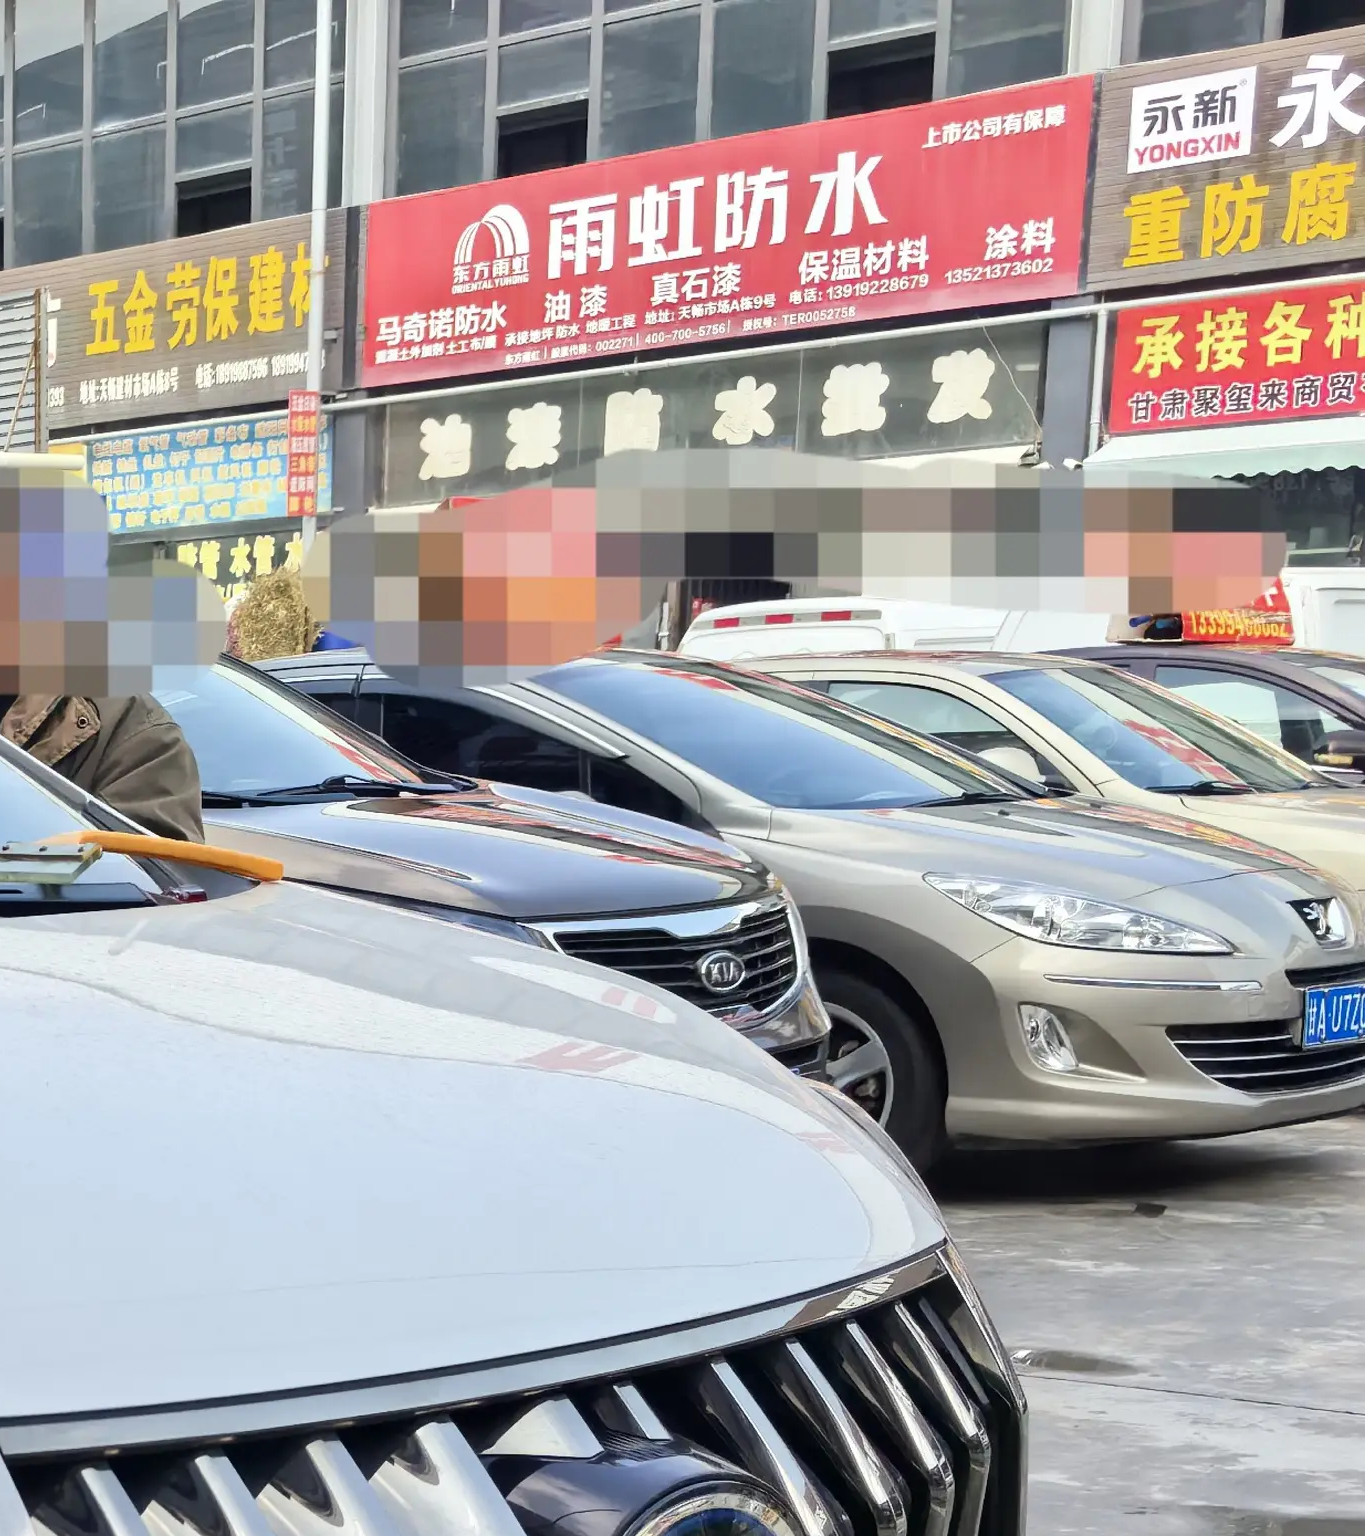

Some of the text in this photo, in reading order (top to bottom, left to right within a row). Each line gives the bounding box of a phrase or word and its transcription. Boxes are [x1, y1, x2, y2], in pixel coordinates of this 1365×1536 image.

[921, 104, 1067, 149] 上市公司有保障
[1143, 84, 1237, 138] 永新
[1134, 131, 1241, 165] YONGXIN
[548, 151, 889, 279] 雨虹防水
[1122, 161, 1358, 268] 重防腐
[376, 301, 507, 346] 马奇诺防水
[650, 263, 742, 306] 真石漆
[798, 235, 929, 285] 保温材料
[984, 217, 1057, 261] 涂料
[451, 273, 529, 295] ORIENTAL YUHONG
[453, 254, 529, 284] 东方雨虹
[944, 257, 1054, 285] 13521373602
[85, 241, 329, 357] 五金劳保建材
[645, 320, 726, 344] 400-700-5756
[1131, 291, 1365, 379] 承接各种
[1127, 371, 1365, 424] 甘肃聚玺来商贸
[709, 961, 740, 984] KIA
